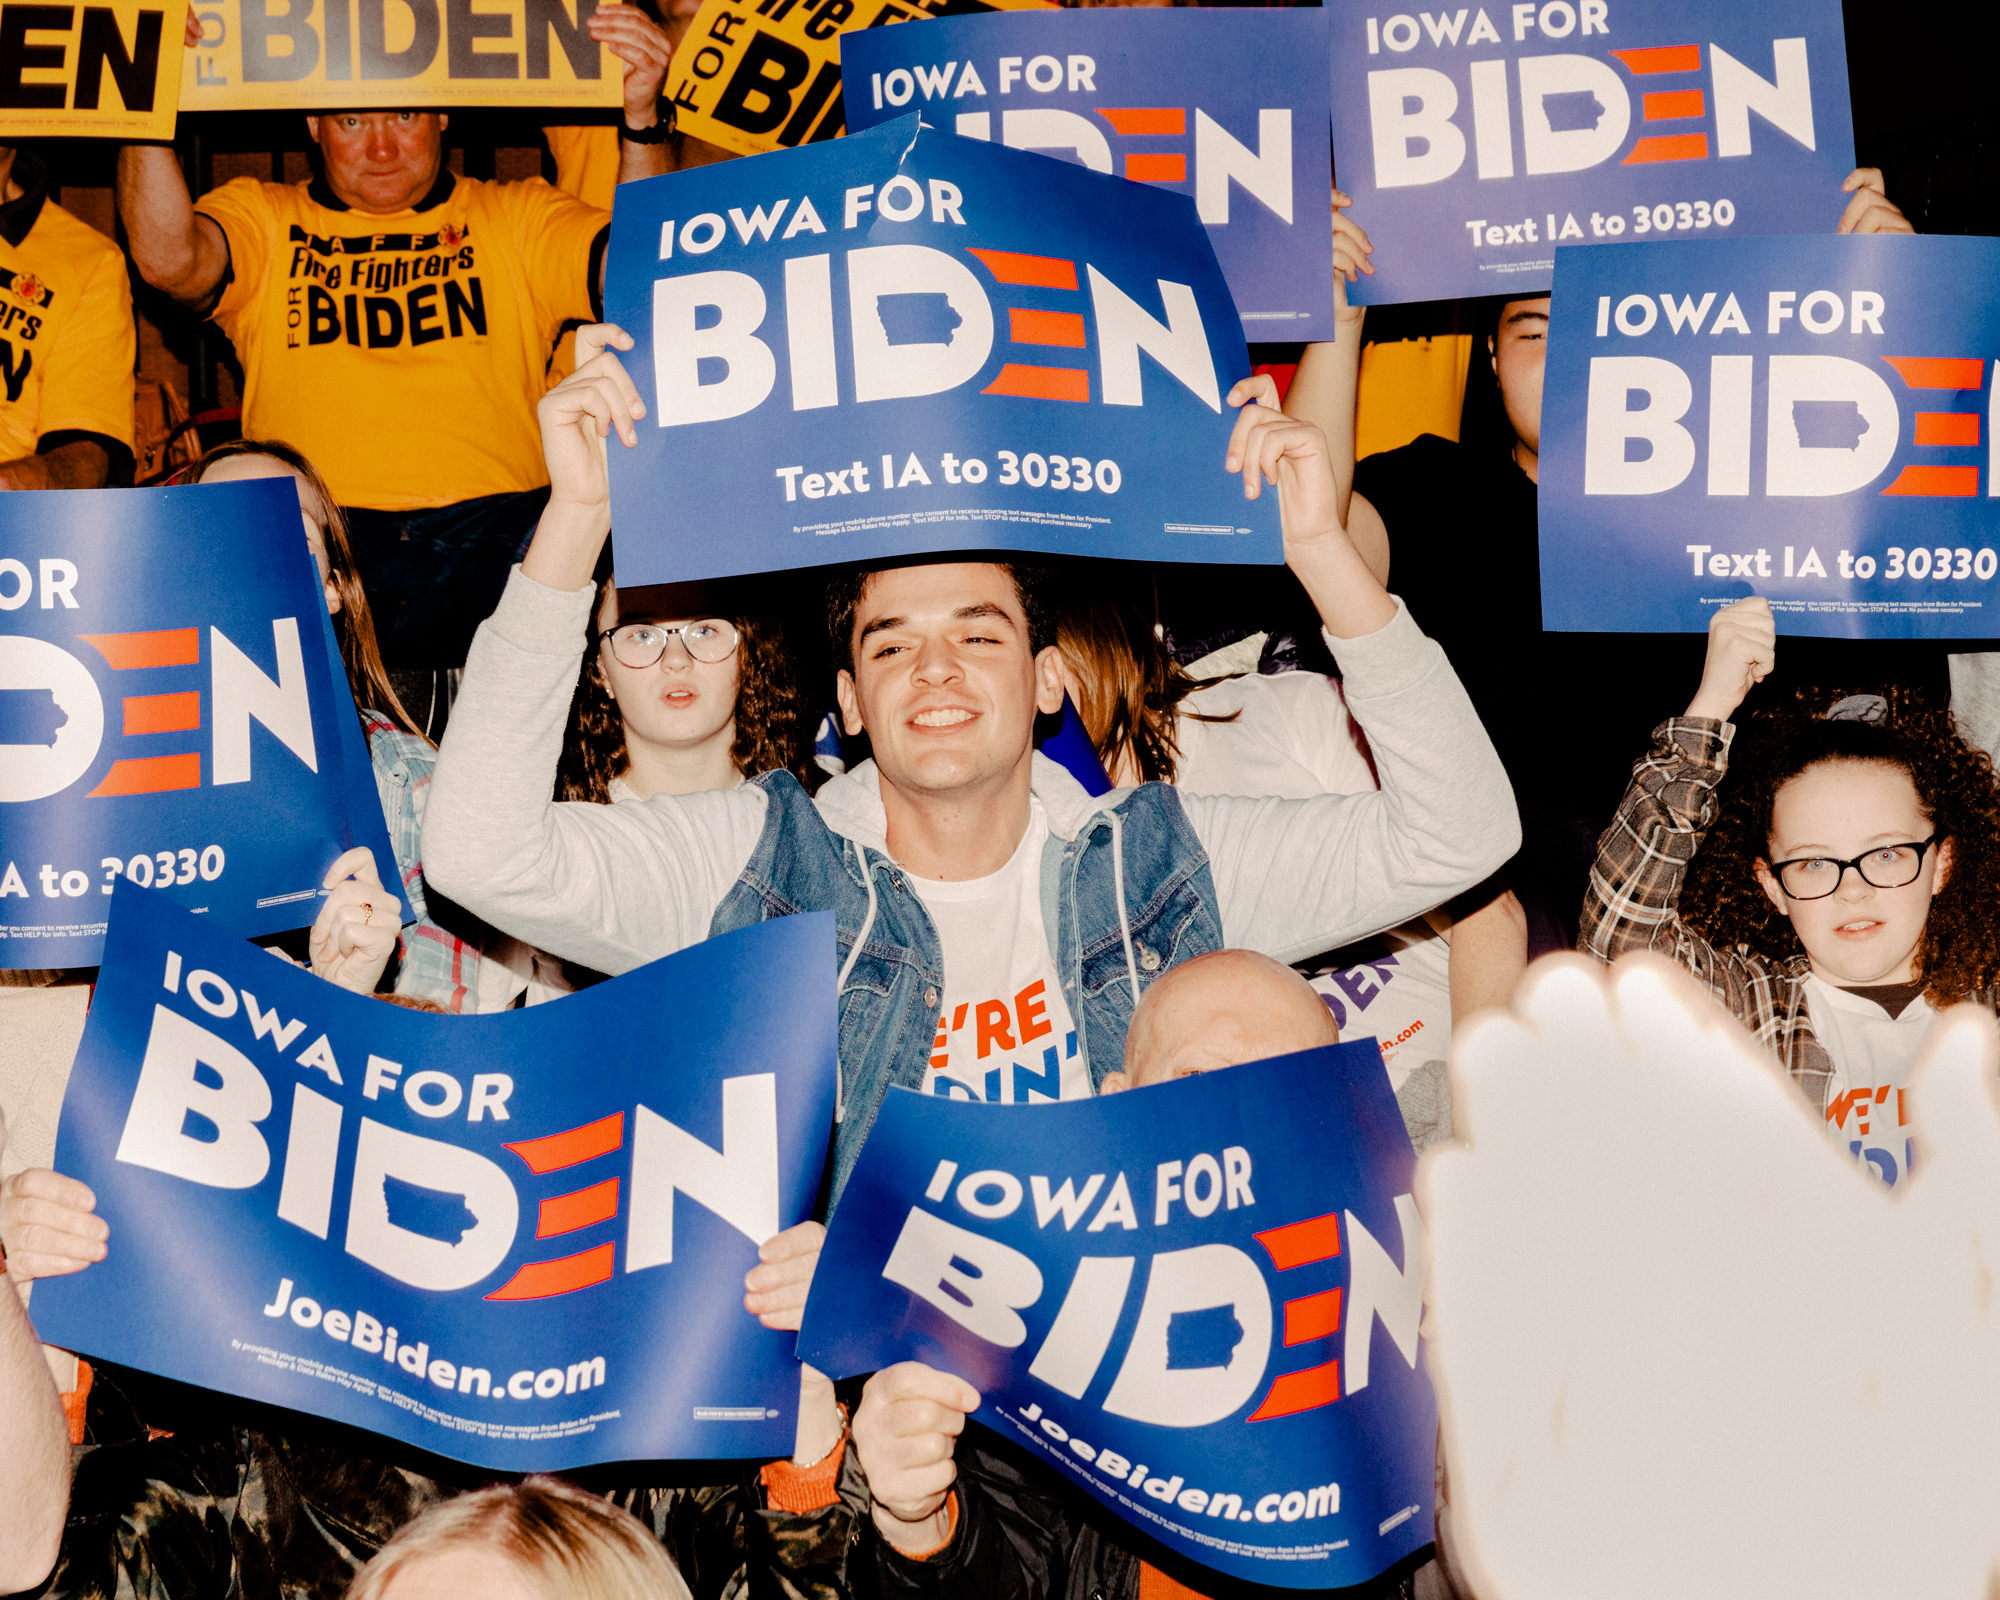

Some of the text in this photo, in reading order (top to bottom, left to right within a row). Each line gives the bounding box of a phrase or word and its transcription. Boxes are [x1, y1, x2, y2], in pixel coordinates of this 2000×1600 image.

[0, 4, 164, 112] EN
[194, 0, 227, 86] FO
[240, 0, 602, 84] BIDEN
[673, 10, 747, 114] FOR
[1367, 0, 1609, 53] IOWA FOR
[710, 29, 847, 146] BI
[873, 55, 1096, 108] IOWA FOR
[1367, 37, 1816, 189] BIDEN
[660, 175, 966, 259] IOWA FOR
[1466, 199, 1735, 247] Text IA to 30330
[290, 246, 474, 293] Fire Fighters
[288, 286, 302, 349] FOR
[308, 277, 487, 349] BIDEN
[653, 244, 1222, 428] BIDEN
[1597, 290, 1885, 336] IOWA FOR
[1584, 355, 2000, 497] BIDE
[776, 451, 1121, 501] Text IA to 30330
[802, 523, 829, 531] providing
[867, 515, 886, 524] phone
[1066, 520, 1092, 529] necessary.
[1687, 545, 1997, 579] Text IA to 30330
[39, 865, 89, 898] to
[102, 845, 224, 894] 30330
[164, 950, 513, 1121] IOWA FOR
[115, 1003, 779, 1302] BIDEN
[926, 1147, 1254, 1233] IOWA FOR
[263, 1277, 606, 1403] JoeBiden.com
[882, 1193, 1424, 1427] BIDEN
[1018, 1402, 1340, 1524] JoeBiden.com
